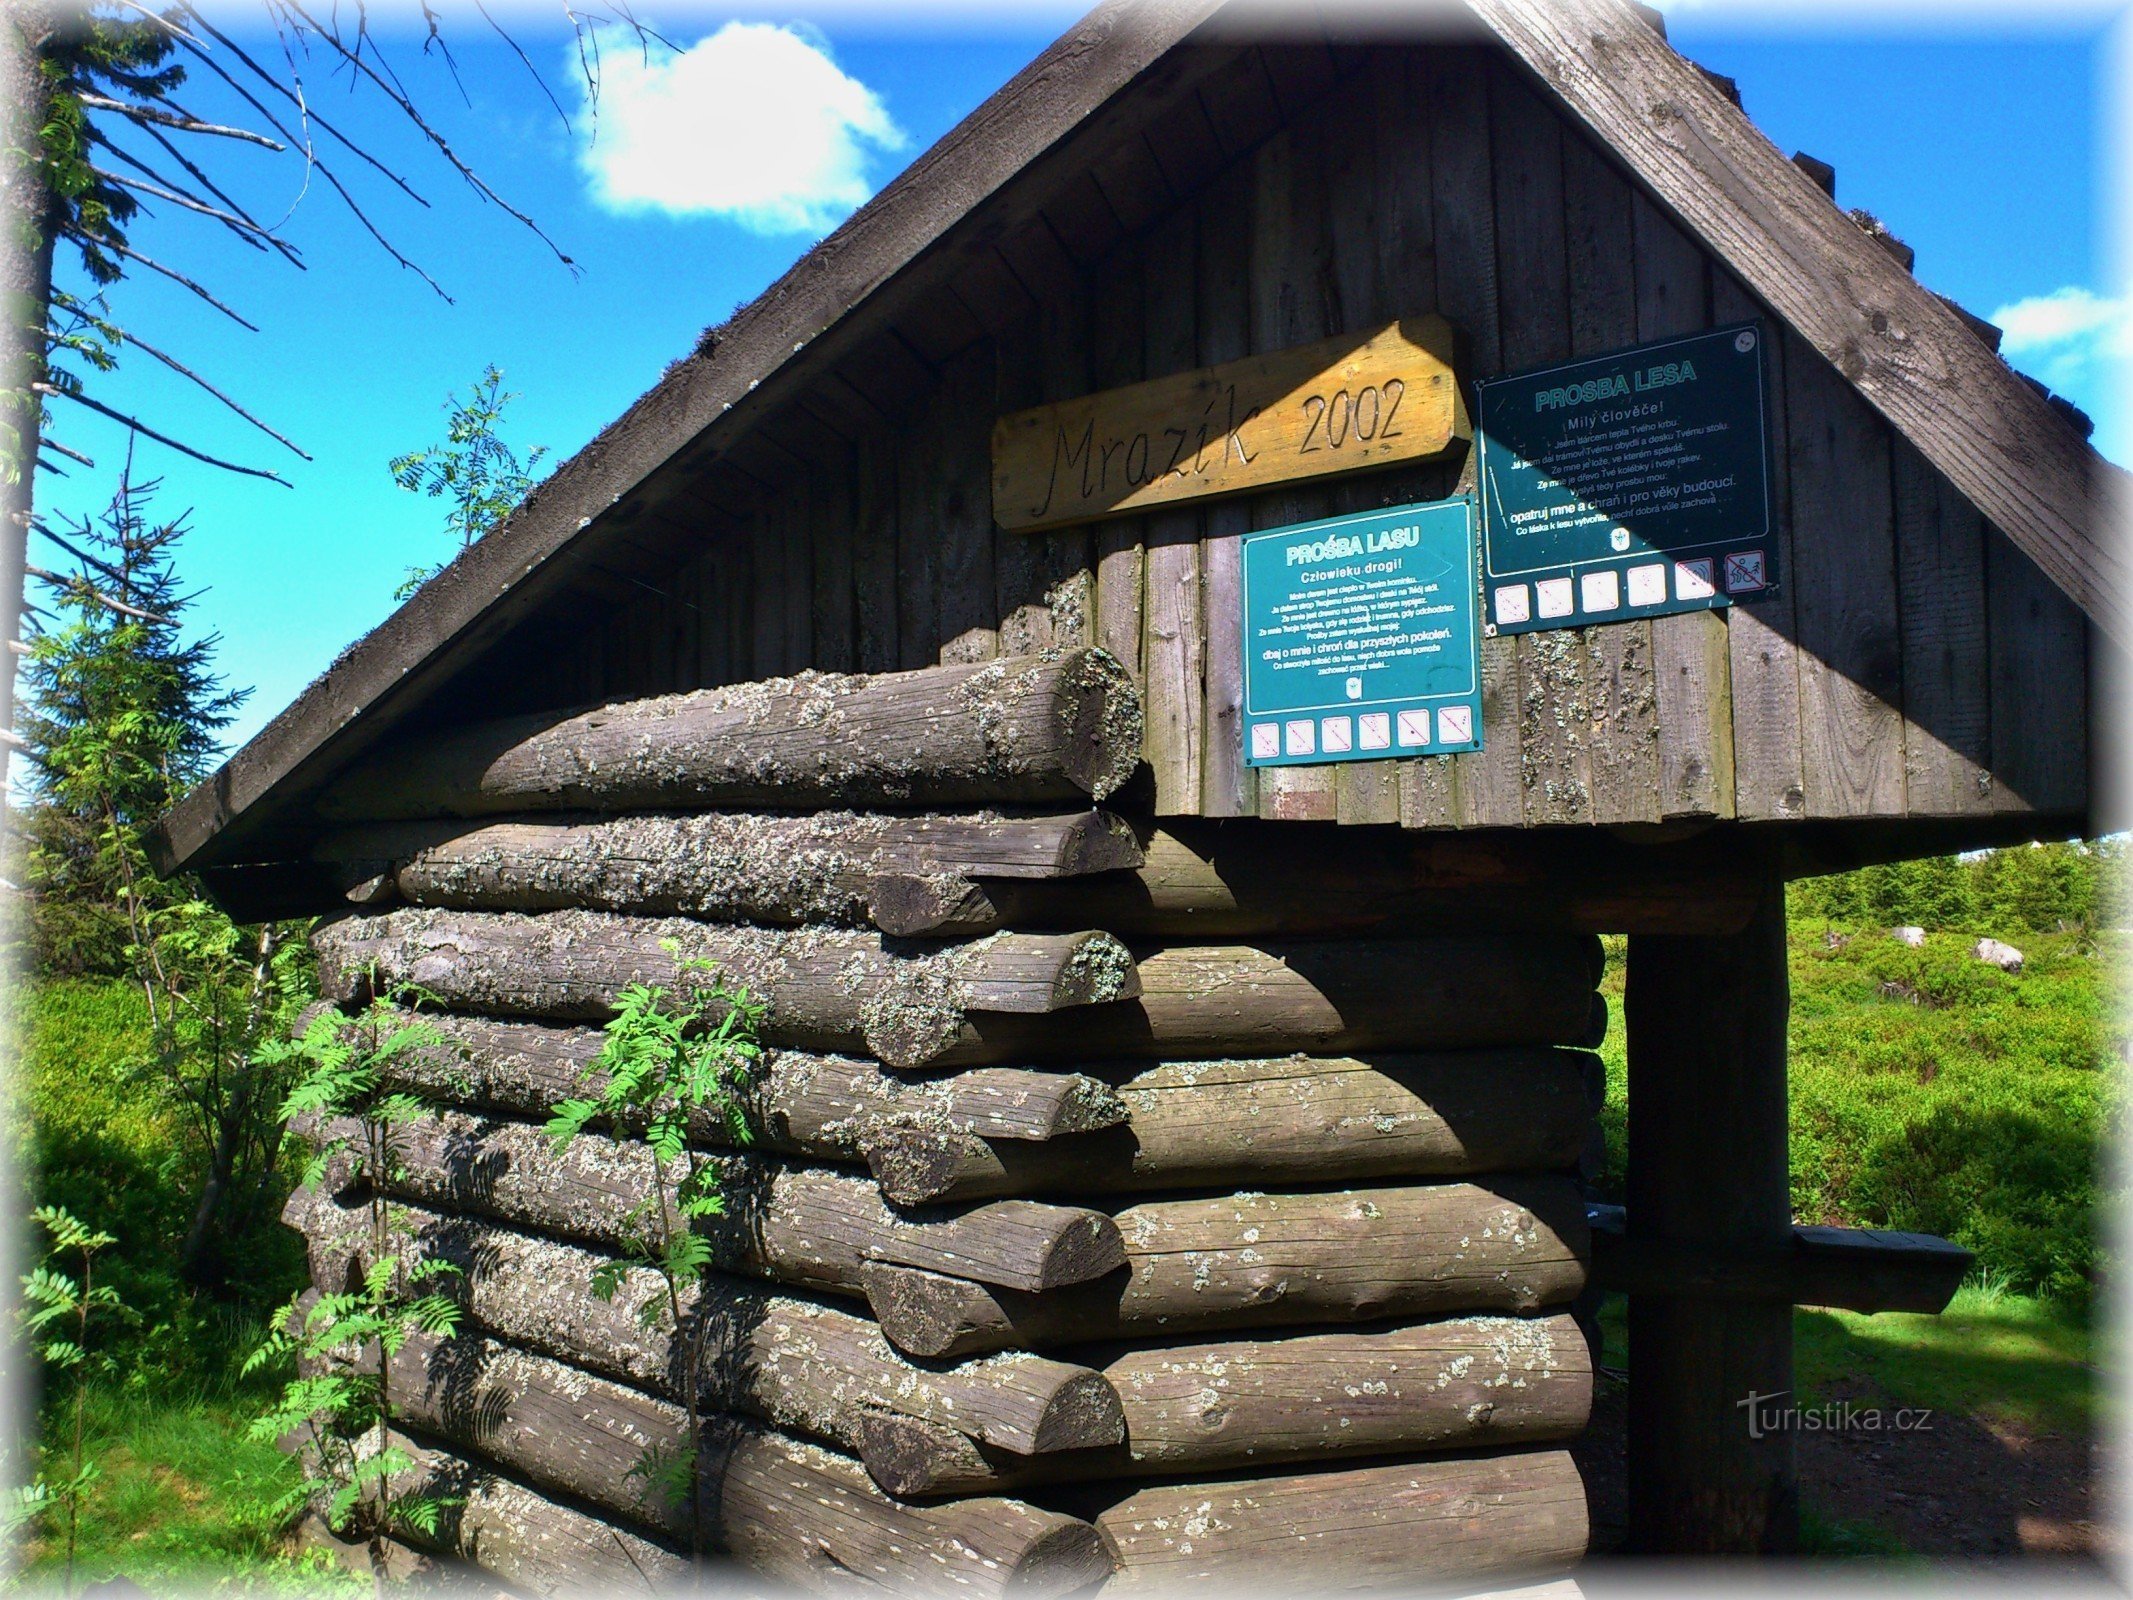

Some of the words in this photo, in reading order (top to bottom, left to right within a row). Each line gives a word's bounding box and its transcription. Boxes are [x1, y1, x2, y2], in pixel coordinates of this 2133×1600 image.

[1535, 375, 1630, 412] PROSBA
[1635, 360, 1697, 392] LESA
[1601, 401, 1664, 423] člověče!
[1554, 440, 1576, 449] Jsem
[1631, 423, 1656, 434] Tvého
[1675, 427, 1704, 438] Tvému
[1032, 384, 1260, 517] Mrazík
[1300, 377, 1405, 454] 2002
[1612, 455, 1622, 463] ve
[1510, 507, 1548, 524] opatruj
[1550, 504, 1576, 516] mne
[1577, 502, 1586, 511] a
[1588, 495, 1620, 511] chraň
[1630, 491, 1649, 505] pro
[1652, 486, 1680, 498] věky
[1683, 475, 1736, 494] budoucí.
[1516, 526, 1528, 536] Co
[1550, 521, 1555, 530] k
[1286, 534, 1364, 566] PROŚBA
[1366, 526, 1419, 554] LASU
[1301, 566, 1361, 584] Człowieku
[1365, 558, 1402, 576] drogi!
[1282, 650, 1289, 658] o
[1290, 645, 1311, 656] mnie
[1317, 640, 1342, 653] chroń
[1344, 640, 1359, 650] dla
